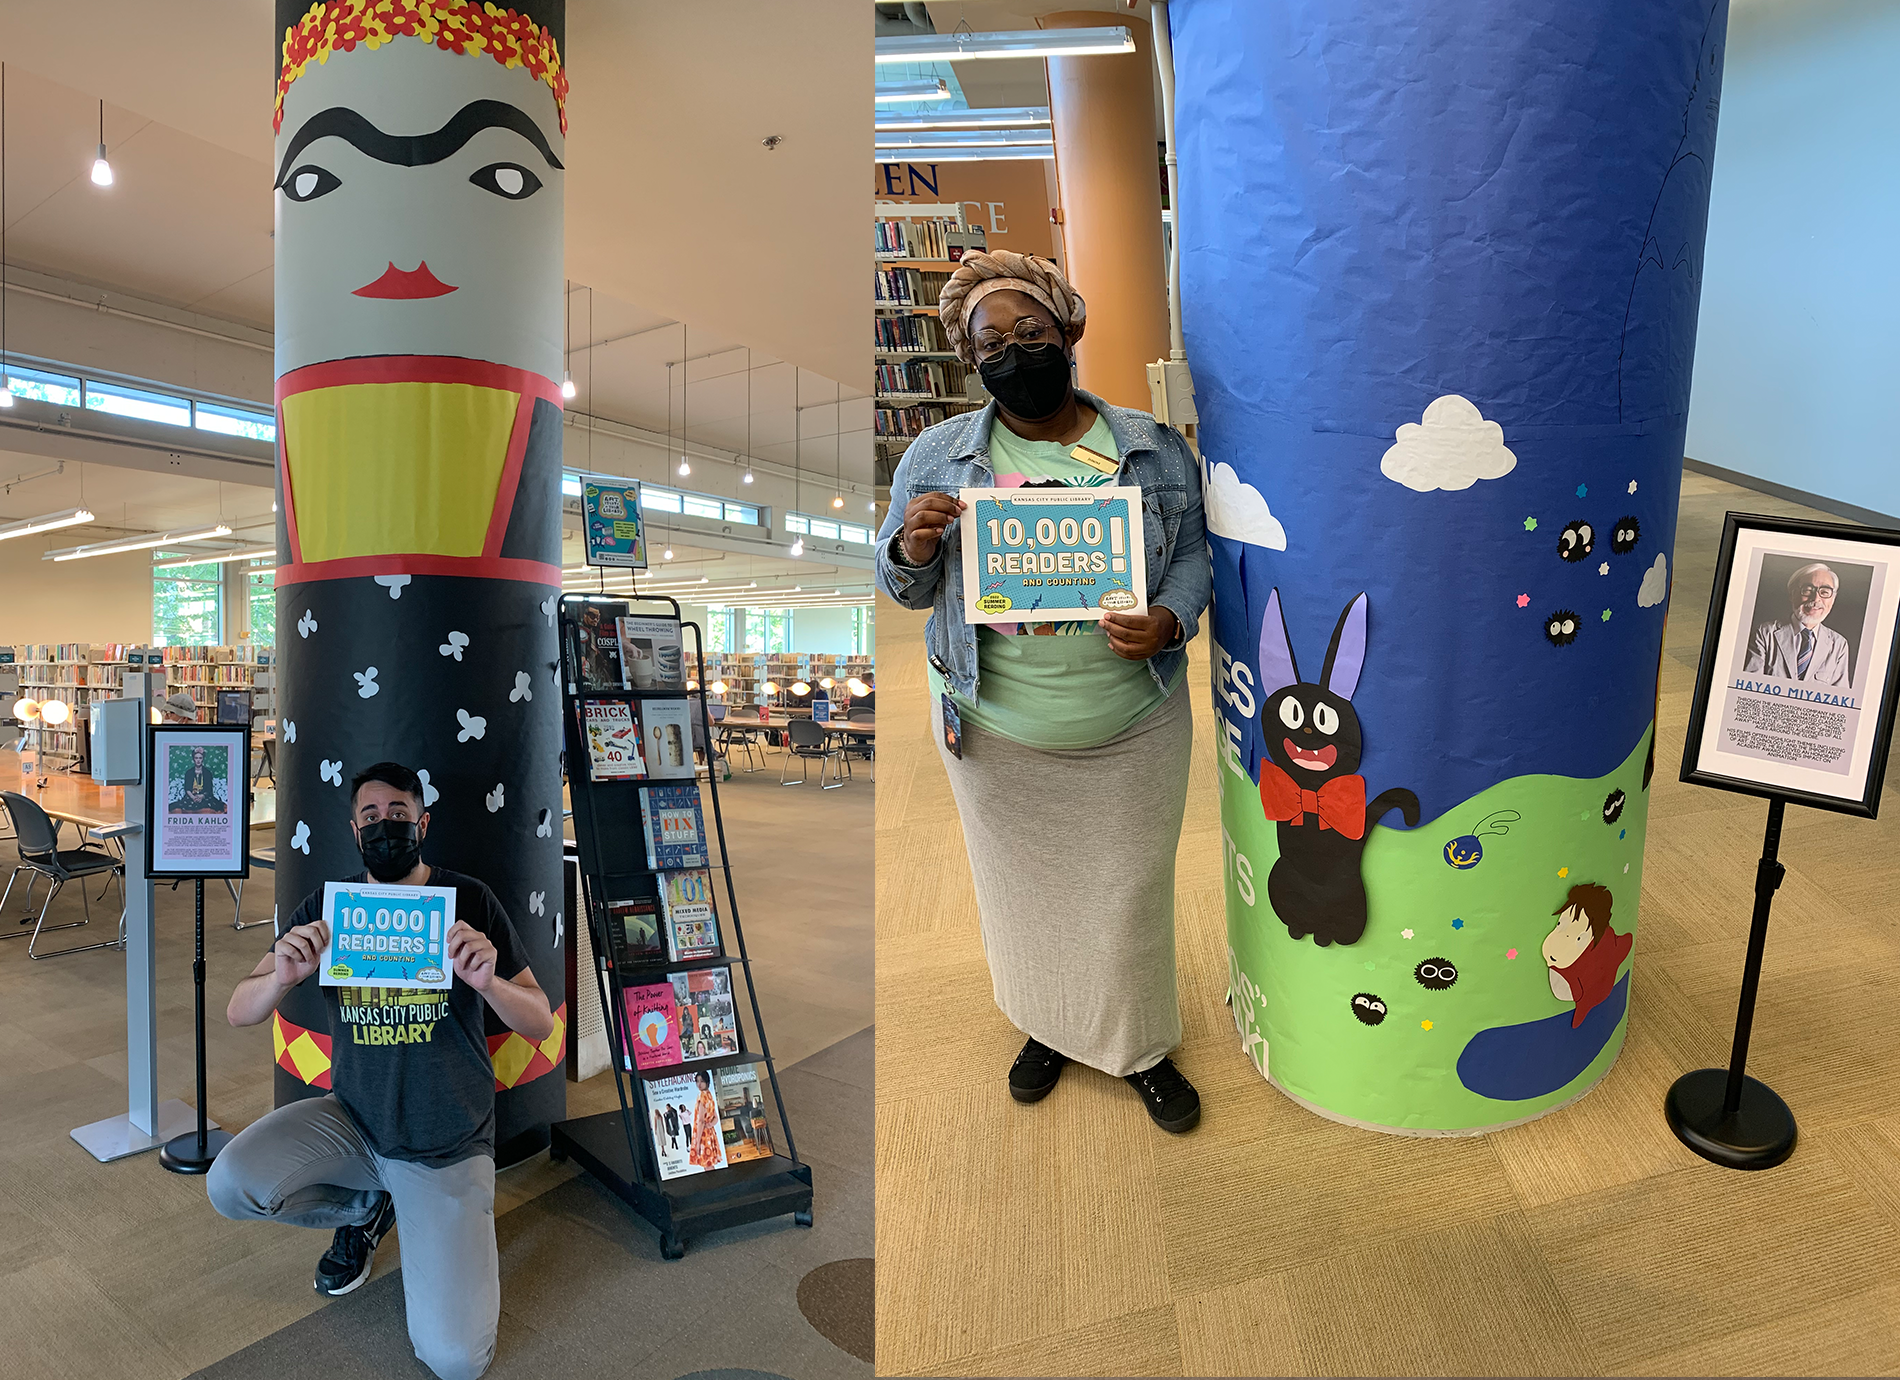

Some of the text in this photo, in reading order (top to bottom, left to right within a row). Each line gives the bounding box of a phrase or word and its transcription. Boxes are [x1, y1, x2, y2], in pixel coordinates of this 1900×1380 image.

[875, 163, 939, 197] EN
[986, 517, 1103, 550] 10,000
[987, 551, 1107, 575] READERS
[1022, 577, 1096, 587] AND COUNTING
[1735, 679, 1855, 708] HAYAO MIYAZAKI
[585, 707, 628, 718] BRICK
[607, 751, 622, 762] 40
[168, 817, 228, 825] FRIDA KAHLO
[664, 818, 693, 831] FIX
[664, 831, 695, 840] STUFF
[671, 876, 706, 902] 101
[341, 907, 425, 933] 10,000
[338, 934, 426, 954] READERS
[379, 955, 416, 963] COUNTING
[634, 990, 664, 1000] The Power
[339, 1002, 449, 1025] KANSAS CITY PUBLIC
[633, 1003, 668, 1017] of Knitting
[353, 1022, 435, 1046] LIBRARY
